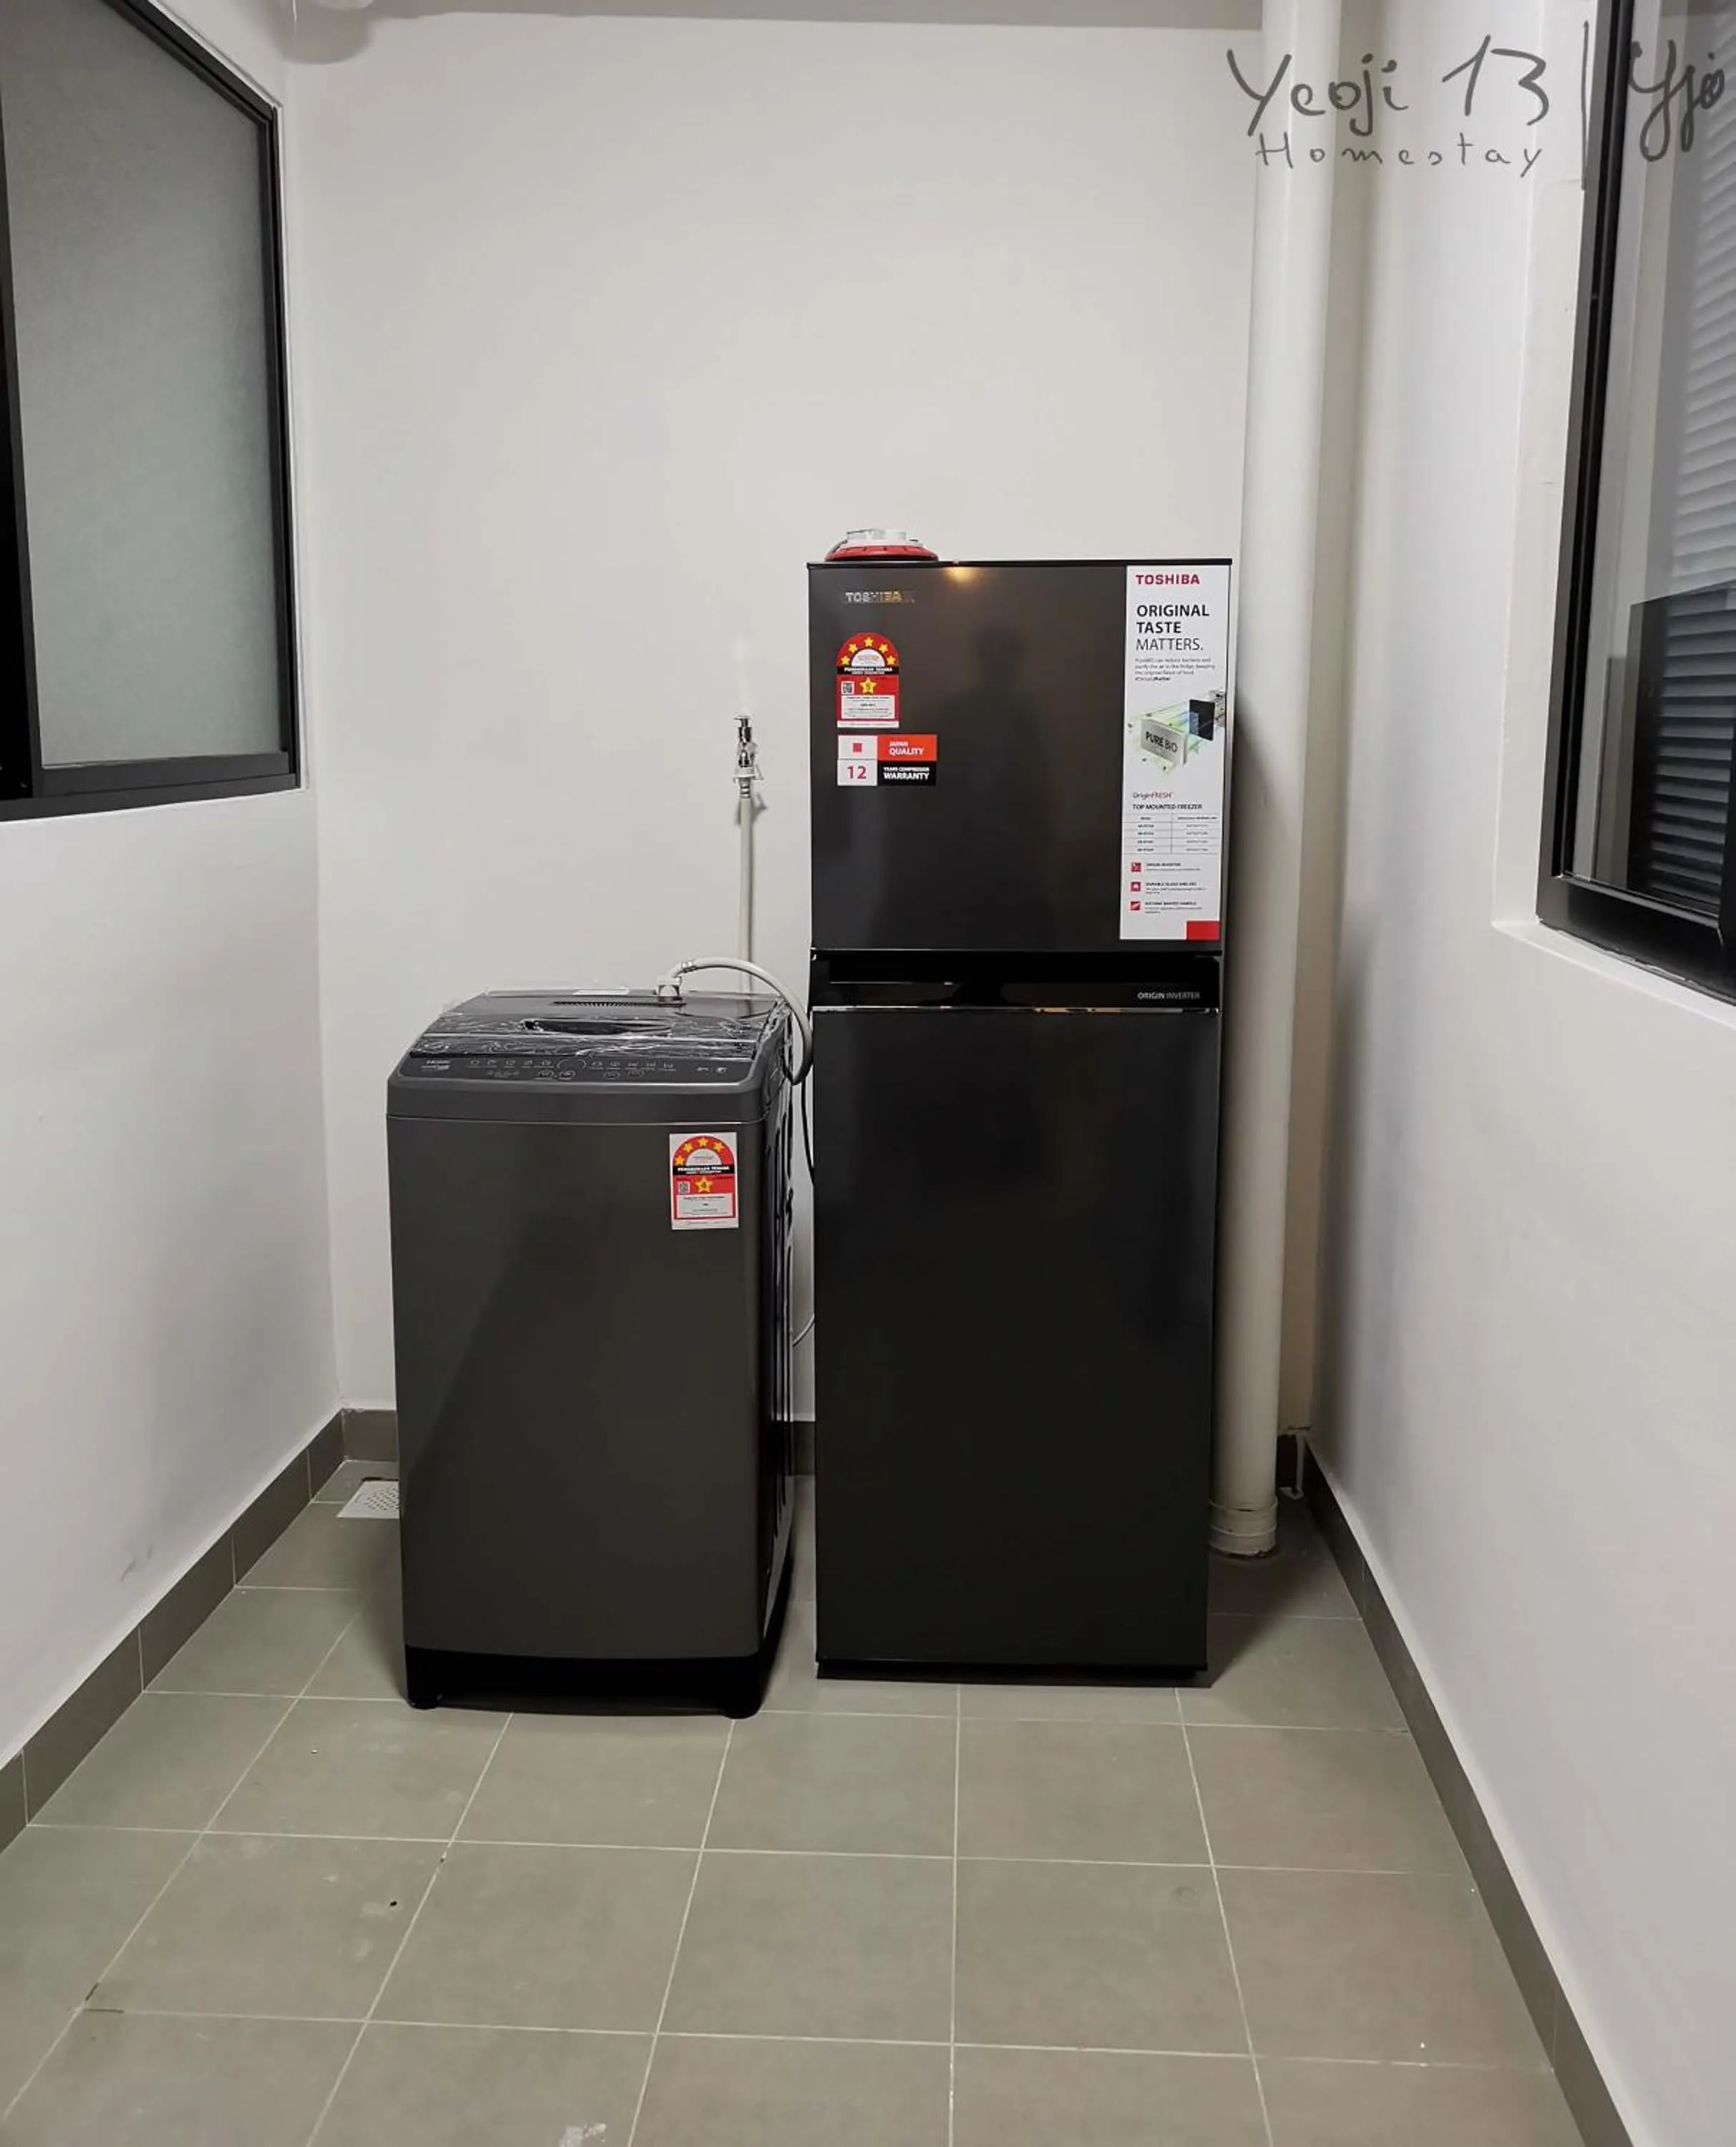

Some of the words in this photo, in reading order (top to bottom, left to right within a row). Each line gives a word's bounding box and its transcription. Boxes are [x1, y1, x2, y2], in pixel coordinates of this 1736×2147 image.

[1135, 575, 1200, 585] TOSHIBA
[1136, 605, 1209, 617] ORIGINAL
[1136, 621, 1182, 633] TASTE
[1136, 638, 1203, 651] MATTERS.
[1145, 731, 1164, 748] PURE
[1165, 740, 1178, 753] BIO
[889, 747, 924, 756] QUALITY
[847, 766, 867, 779] 12
[1166, 991, 1200, 1000] INVERTER
